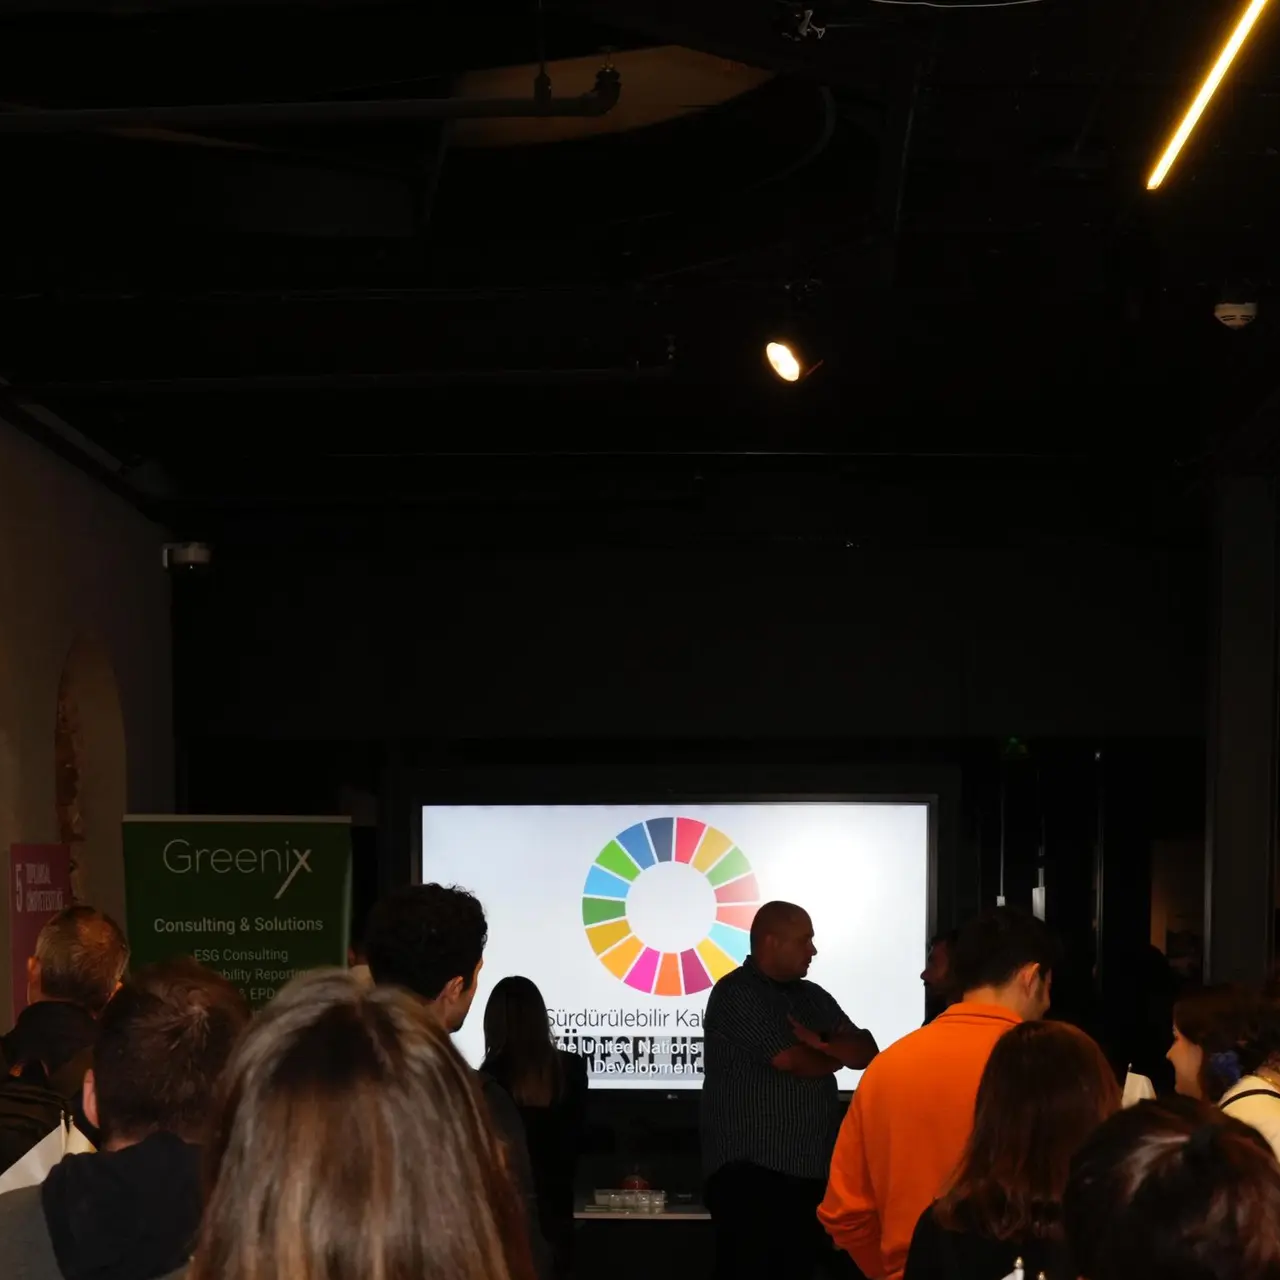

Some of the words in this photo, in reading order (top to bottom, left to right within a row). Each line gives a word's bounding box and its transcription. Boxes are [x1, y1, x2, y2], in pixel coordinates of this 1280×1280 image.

[163, 838, 312, 899] Greenix
[15, 863, 23, 913] 5
[154, 917, 236, 935] Consulting
[240, 916, 250, 931] &
[255, 916, 324, 931] Solutions
[195, 949, 220, 961] ESG
[223, 948, 289, 963] Consulting
[546, 1008, 670, 1027] Sürdürülebilir
[582, 1039, 633, 1055] United
[638, 1040, 699, 1055] Nations
[593, 1059, 699, 1077] Development
